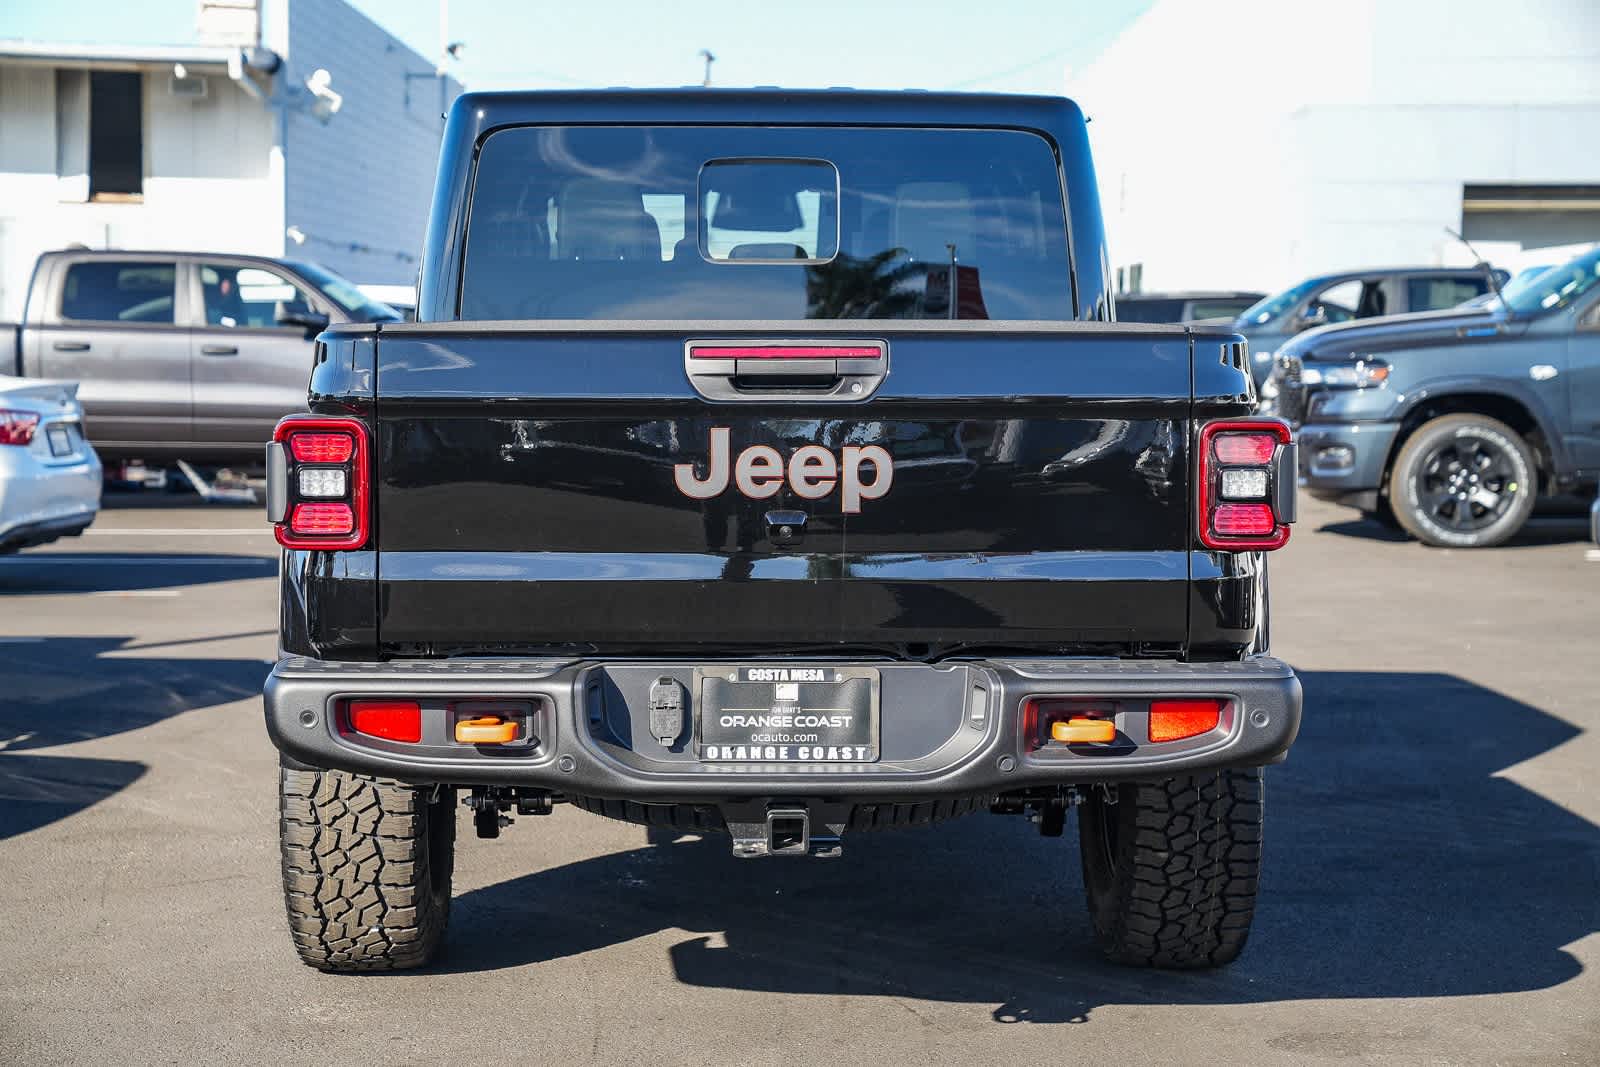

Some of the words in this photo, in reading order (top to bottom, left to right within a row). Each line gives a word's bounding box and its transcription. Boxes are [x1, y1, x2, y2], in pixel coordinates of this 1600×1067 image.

[673, 426, 895, 514] Jeep
[748, 669, 789, 681] COSTA
[790, 669, 825, 681] MESA
[720, 716, 793, 728] ORANGE
[794, 716, 853, 728] COAST
[751, 732, 818, 743] ocauto.com
[706, 746, 788, 760] ORANGE
[798, 746, 867, 760] COAST
